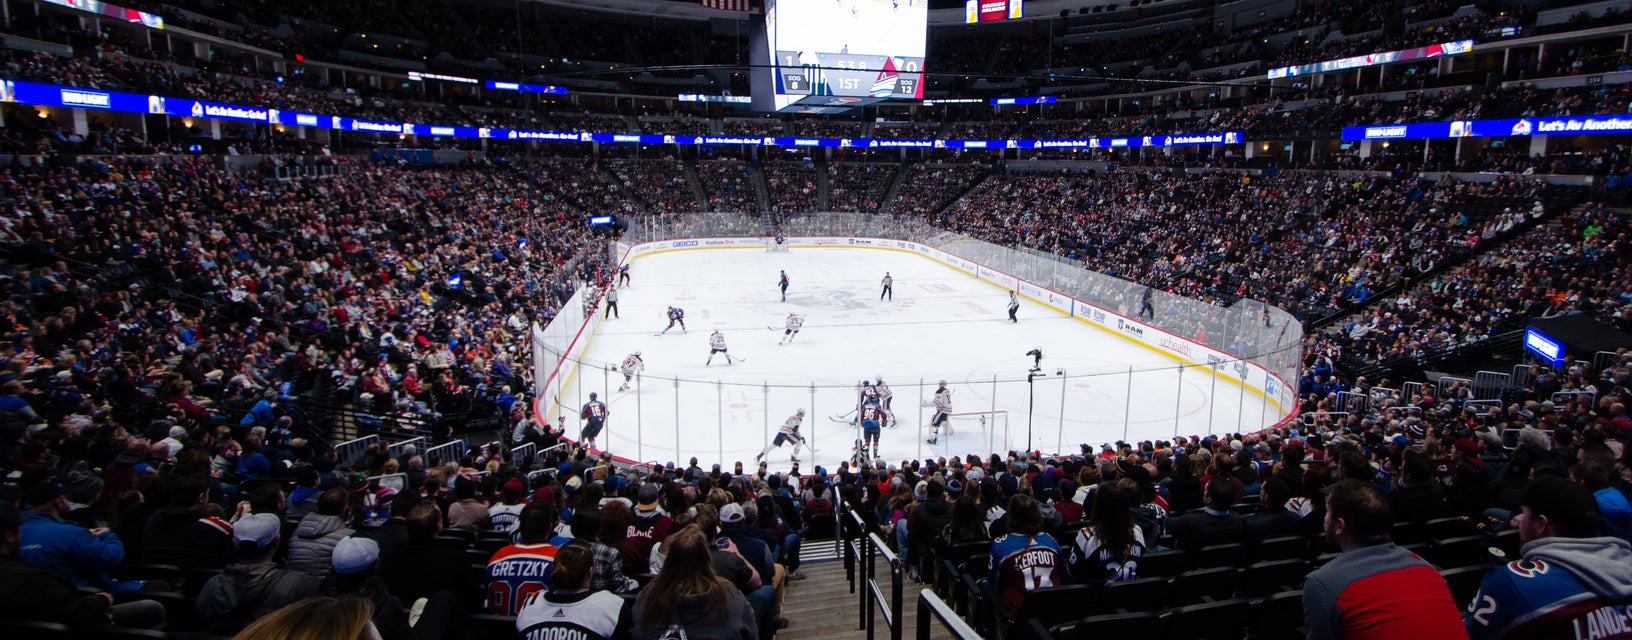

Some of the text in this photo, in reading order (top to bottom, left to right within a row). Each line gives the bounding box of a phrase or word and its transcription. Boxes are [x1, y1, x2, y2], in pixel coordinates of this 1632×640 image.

[838, 77, 860, 89] 1ST
[901, 86, 912, 94] 12
[1538, 121, 1566, 131] Let's
[1566, 120, 1582, 130] Av
[1125, 323, 1143, 335] RAM
[1160, 337, 1192, 356] uchealth
[864, 409, 875, 420] 96
[492, 560, 549, 577] GRETZKY
